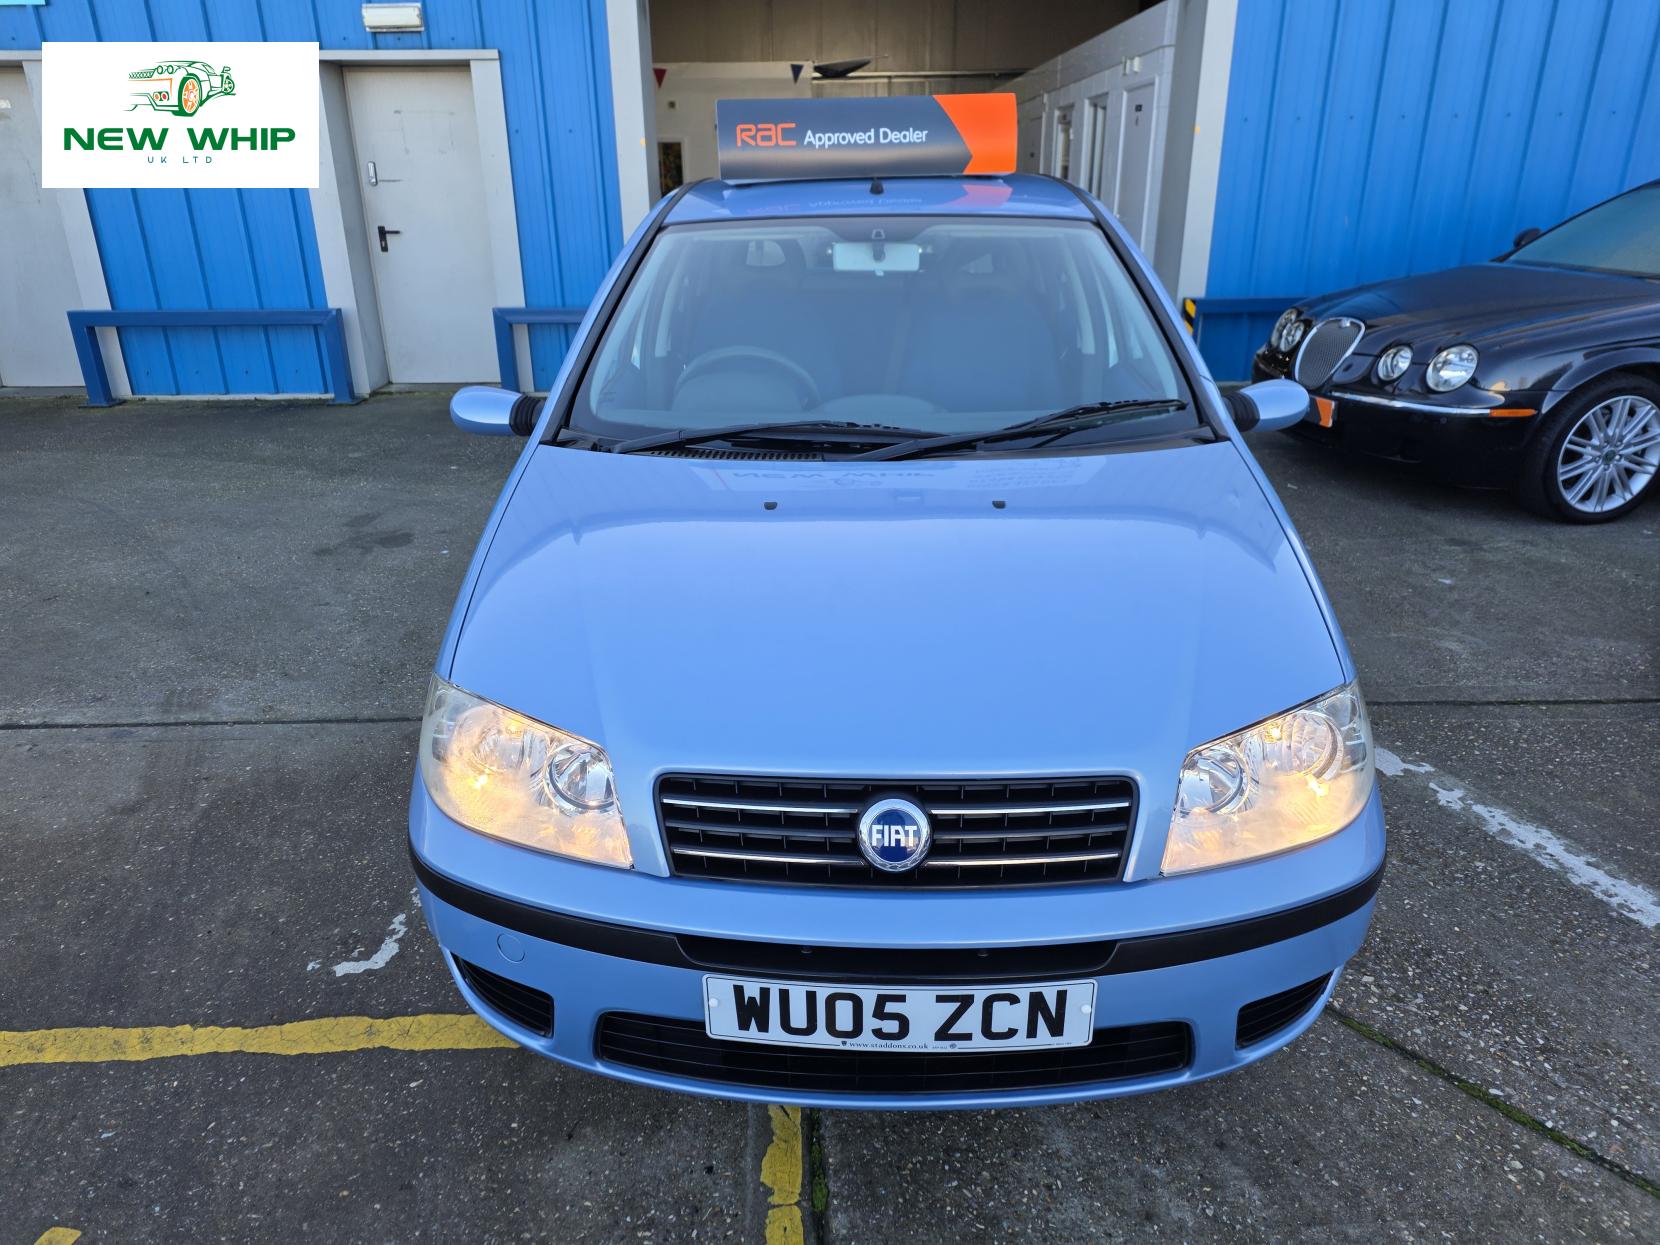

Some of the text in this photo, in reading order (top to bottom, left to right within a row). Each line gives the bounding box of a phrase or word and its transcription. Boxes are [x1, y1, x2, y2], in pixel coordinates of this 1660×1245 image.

[803, 128, 875, 149] Approved
[879, 127, 929, 144] Dealer
[871, 824, 918, 848] FIAT
[732, 984, 1069, 1042] WU05 ZCN
